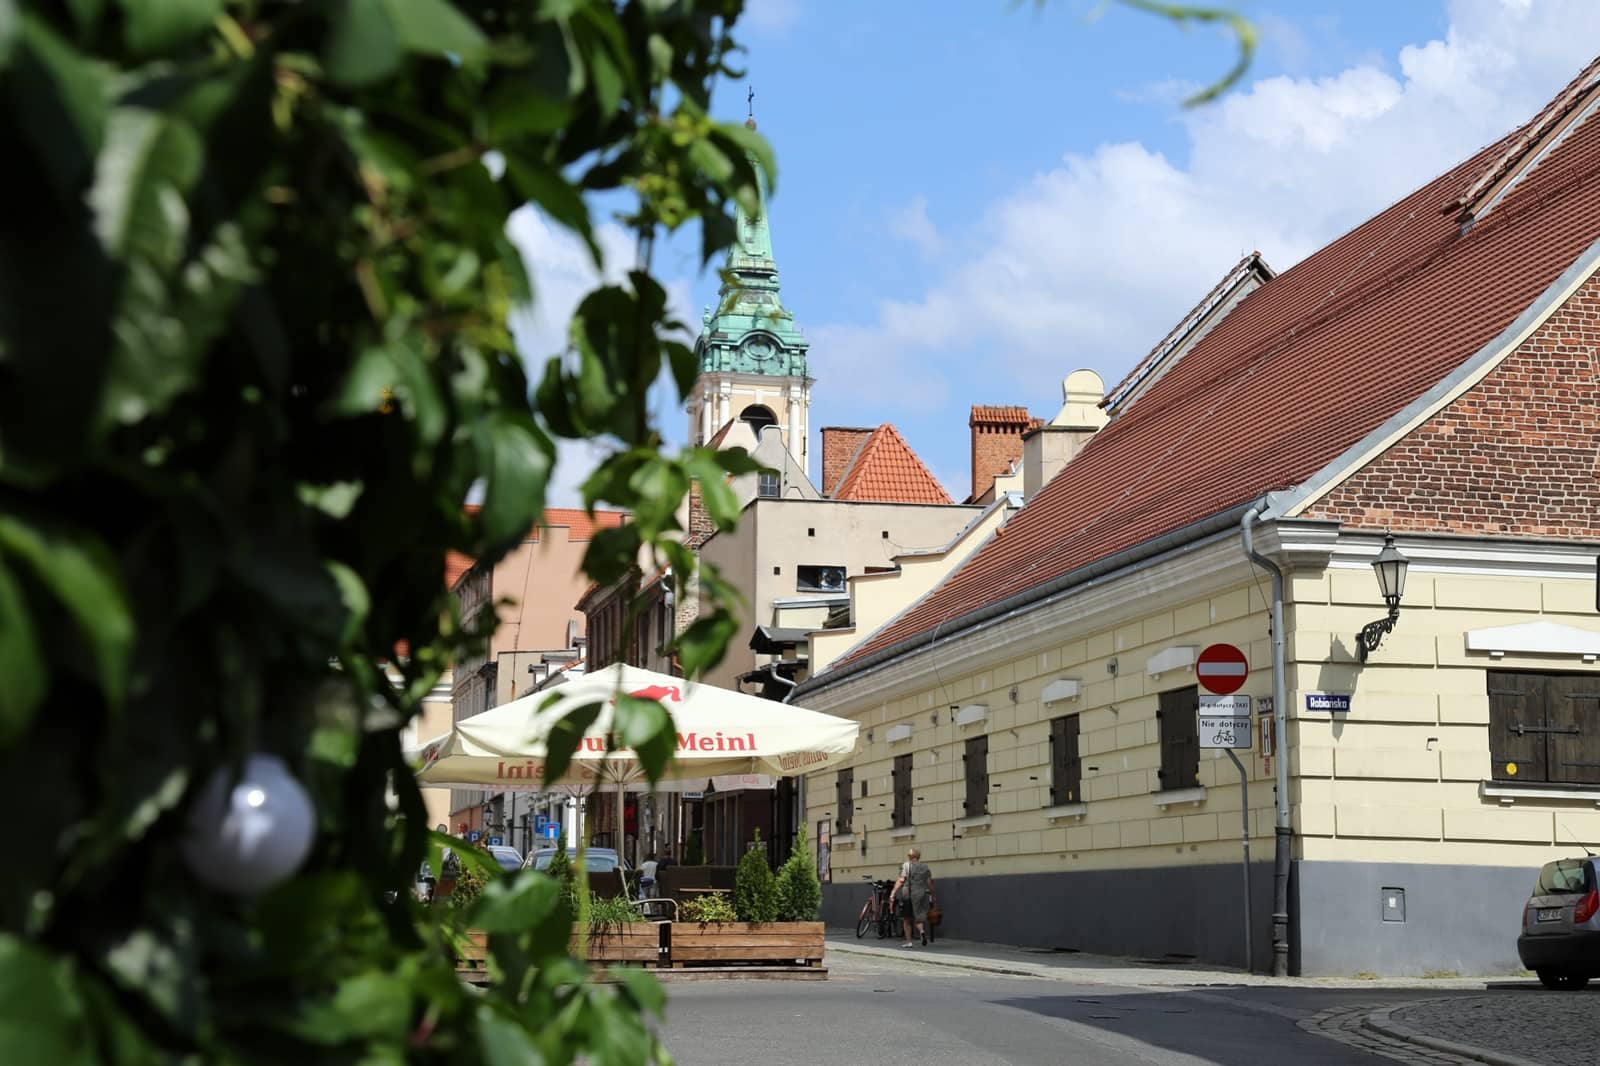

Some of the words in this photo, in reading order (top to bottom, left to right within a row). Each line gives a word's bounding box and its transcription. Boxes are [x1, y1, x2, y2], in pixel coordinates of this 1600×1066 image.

[1202, 720, 1215, 728] Nie
[1219, 720, 1249, 729] dotyczy
[675, 732, 757, 752] Meinl
